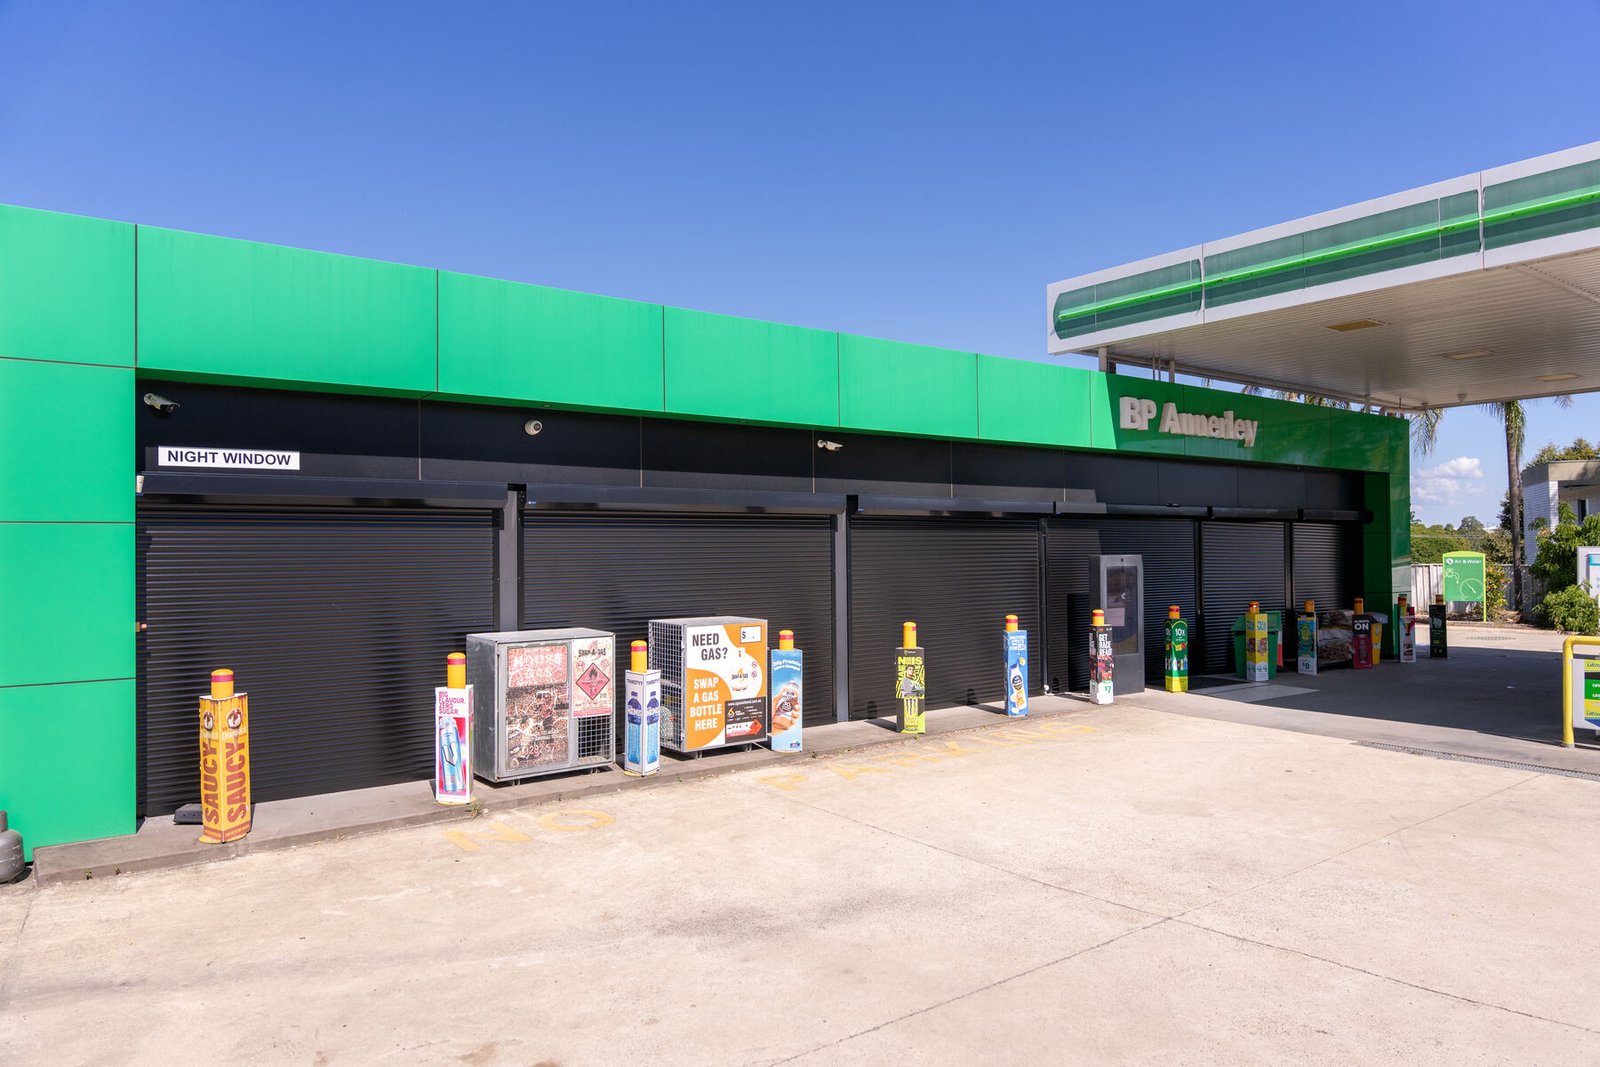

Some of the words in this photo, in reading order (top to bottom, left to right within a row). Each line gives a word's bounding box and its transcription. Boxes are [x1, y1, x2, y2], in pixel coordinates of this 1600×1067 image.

[1119, 396, 1157, 431] BP
[1158, 402, 1258, 448] Annerley
[167, 450, 219, 463] NIGHT
[222, 452, 291, 466] WINDOW
[692, 633, 720, 647] NEED
[742, 630, 746, 640] $
[701, 647, 728, 661] GAS?
[693, 677, 719, 690] SWAP
[693, 692, 700, 704] A
[702, 690, 719, 702] GAS
[689, 704, 723, 718] BOTTLE
[694, 718, 718, 731] HERE
[202, 742, 219, 825] SAUCY
[226, 742, 247, 823] SAUCY
[442, 809, 616, 852] NO
